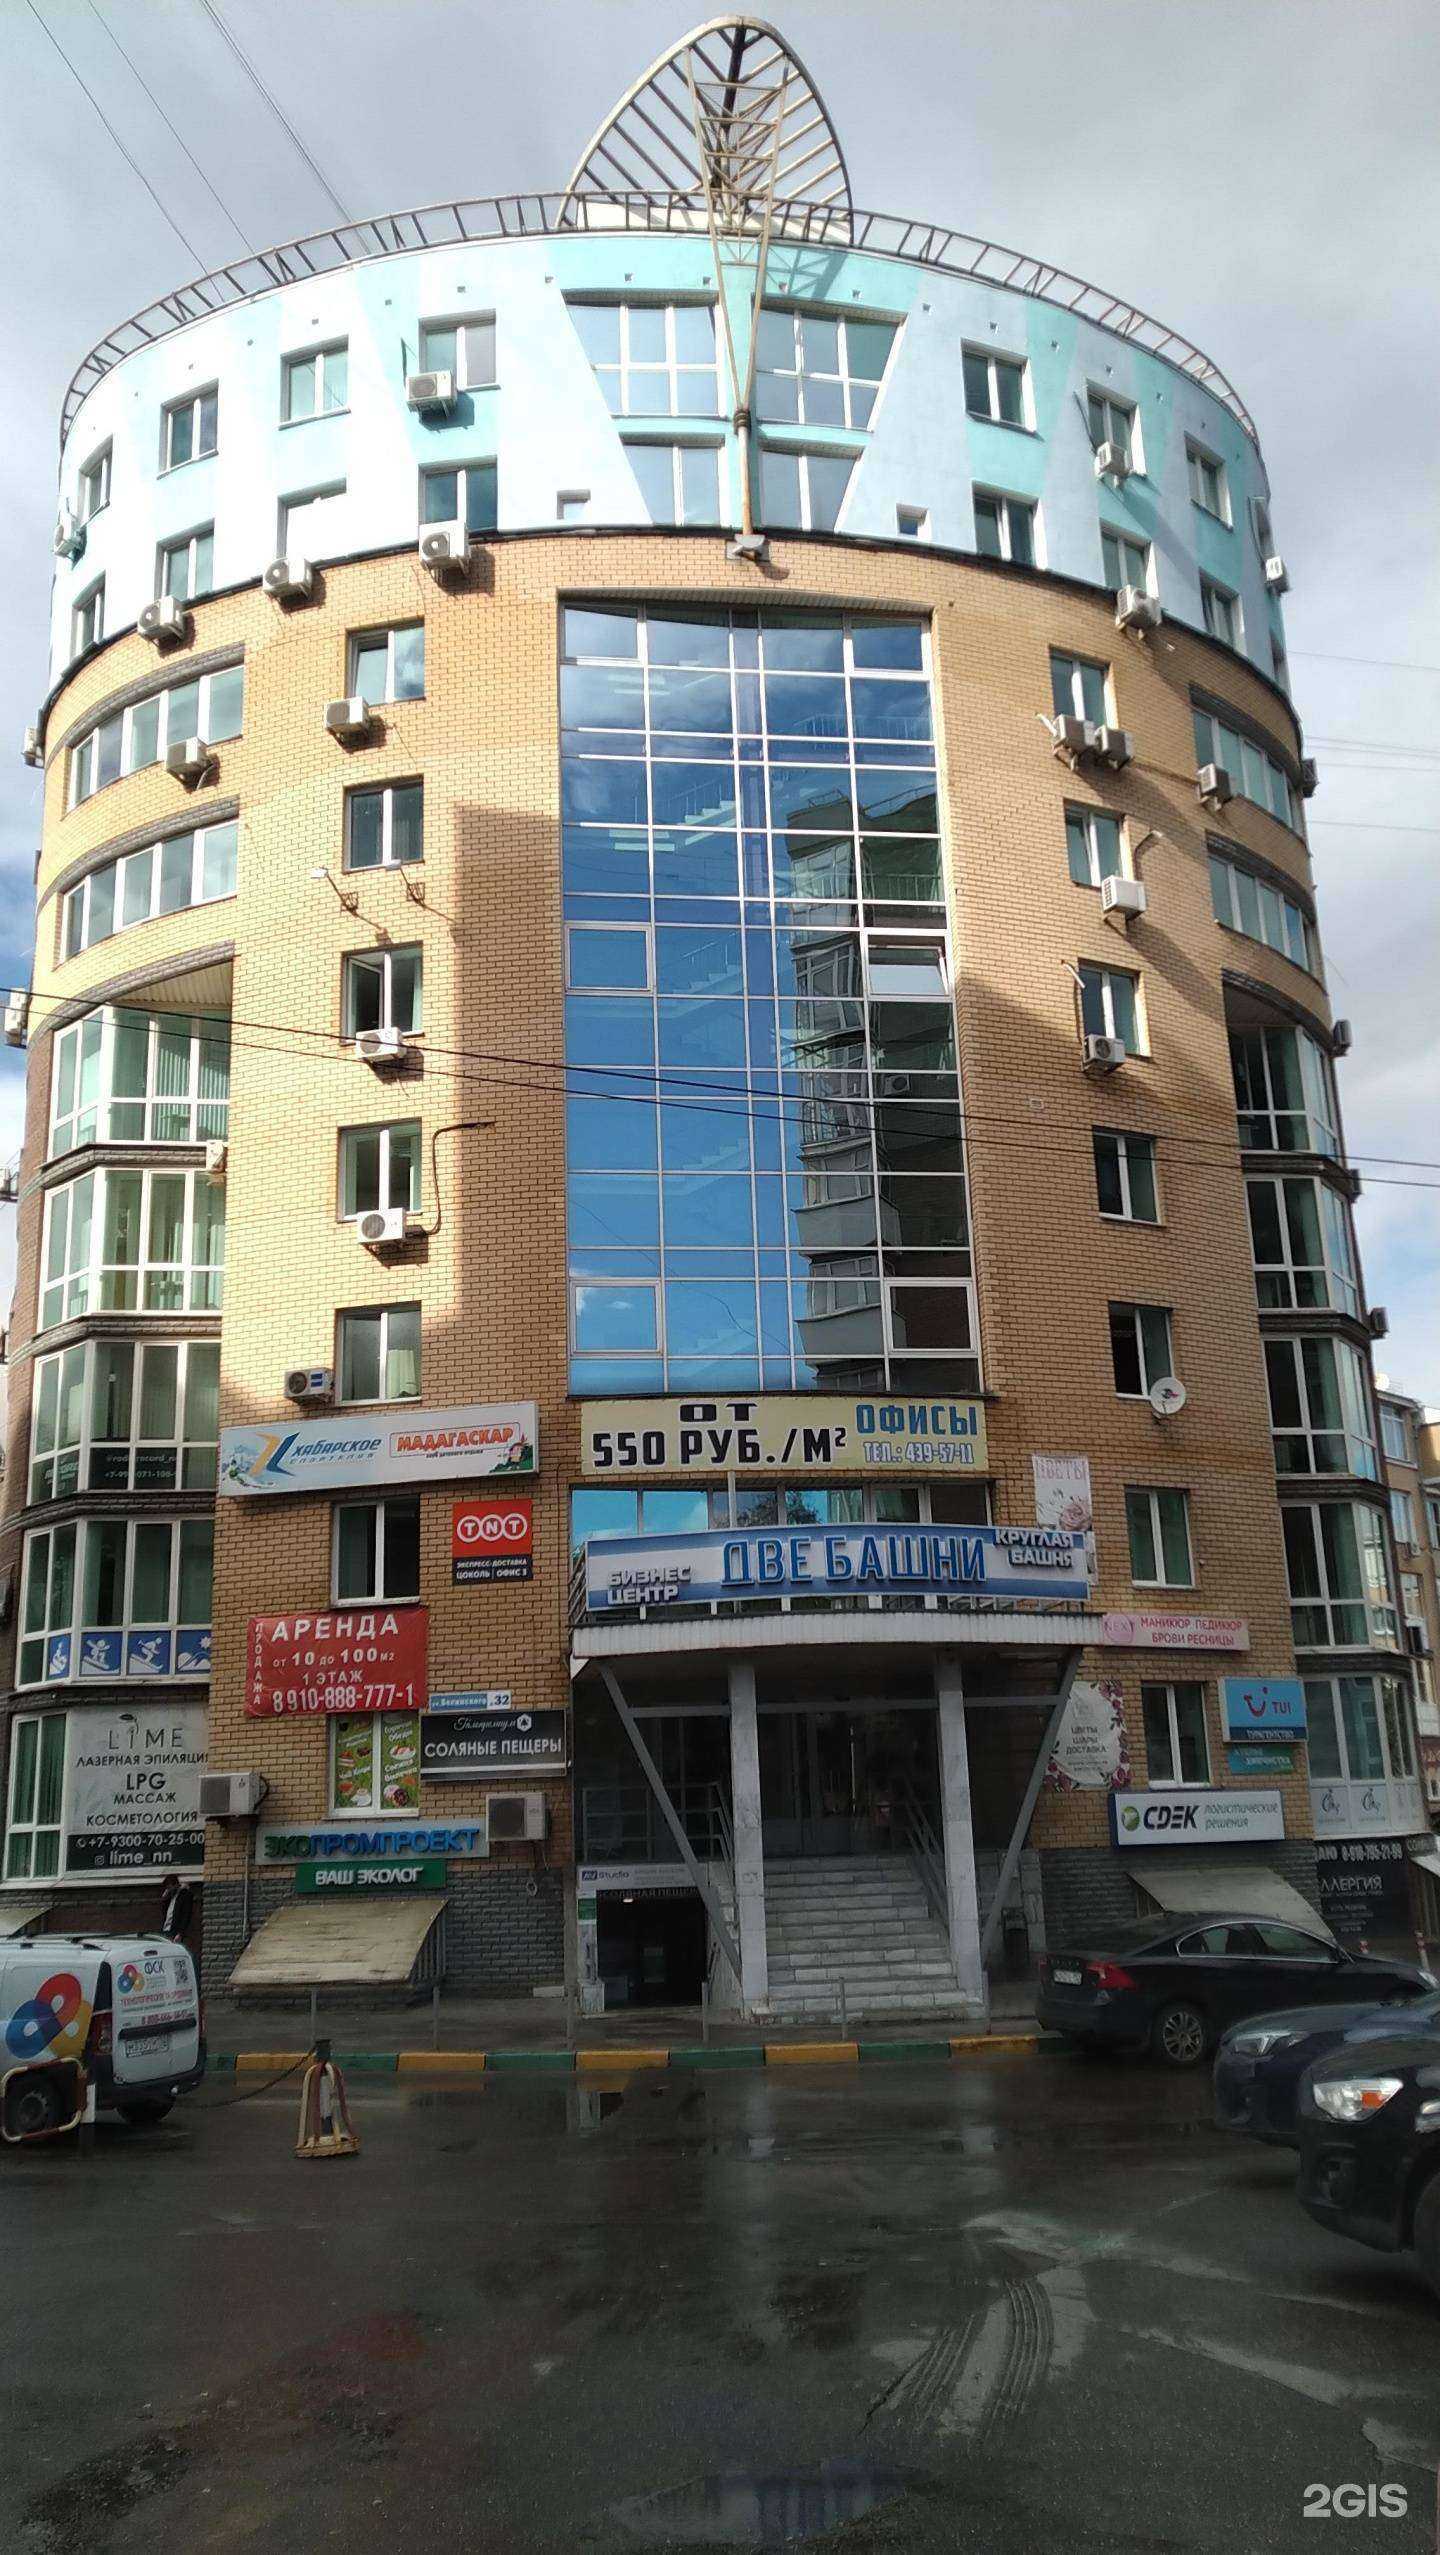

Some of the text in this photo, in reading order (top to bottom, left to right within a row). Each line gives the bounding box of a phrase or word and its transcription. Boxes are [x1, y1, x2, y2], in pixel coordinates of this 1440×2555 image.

[680, 1403, 757, 1423] ОТ
[856, 1404, 978, 1436] ОФИСЫ
[397, 1427, 514, 1452] МАДАГАСКАР
[593, 1430, 665, 1467] 550
[905, 1441, 975, 1464] 439-57-11
[460, 1515, 523, 1540] TNT
[995, 1528, 1074, 1548] КРУГЛАЯ
[720, 1534, 988, 1587] ДВЕ БАШНИ
[1010, 1550, 1074, 1568] БАШНЯ
[609, 1565, 692, 1588] БИЗНЕС
[608, 1585, 679, 1606] ЦЕНТР
[271, 1614, 400, 1643] АРЕНДА
[1140, 1616, 1242, 1631] МАНИКЮР ПЕДИКЮР
[1152, 1632, 1235, 1646] БРОВИ РЕСНИЦЫ
[291, 1651, 315, 1667] 10
[340, 1647, 378, 1664] 100
[316, 1669, 364, 1685] ЭТАЖ
[1271, 1701, 1293, 1714] TUI
[424, 1738, 562, 1758] СОЛЯНЫЕ ПЕЩЕРЫ
[76, 1755, 140, 1769] ЛАЗЕРНАЯ
[126, 1772, 166, 1791] LPG
[113, 1791, 177, 1805] МАССАЖ
[86, 1811, 198, 1826] КОСМЕТОЛОГИЯ
[1143, 1805, 1200, 1830] CDEK
[264, 1828, 480, 1858] ЭКОПРОМПРОЕКТ
[315, 1867, 424, 1885] ВАШ ЭКОЛОГ
